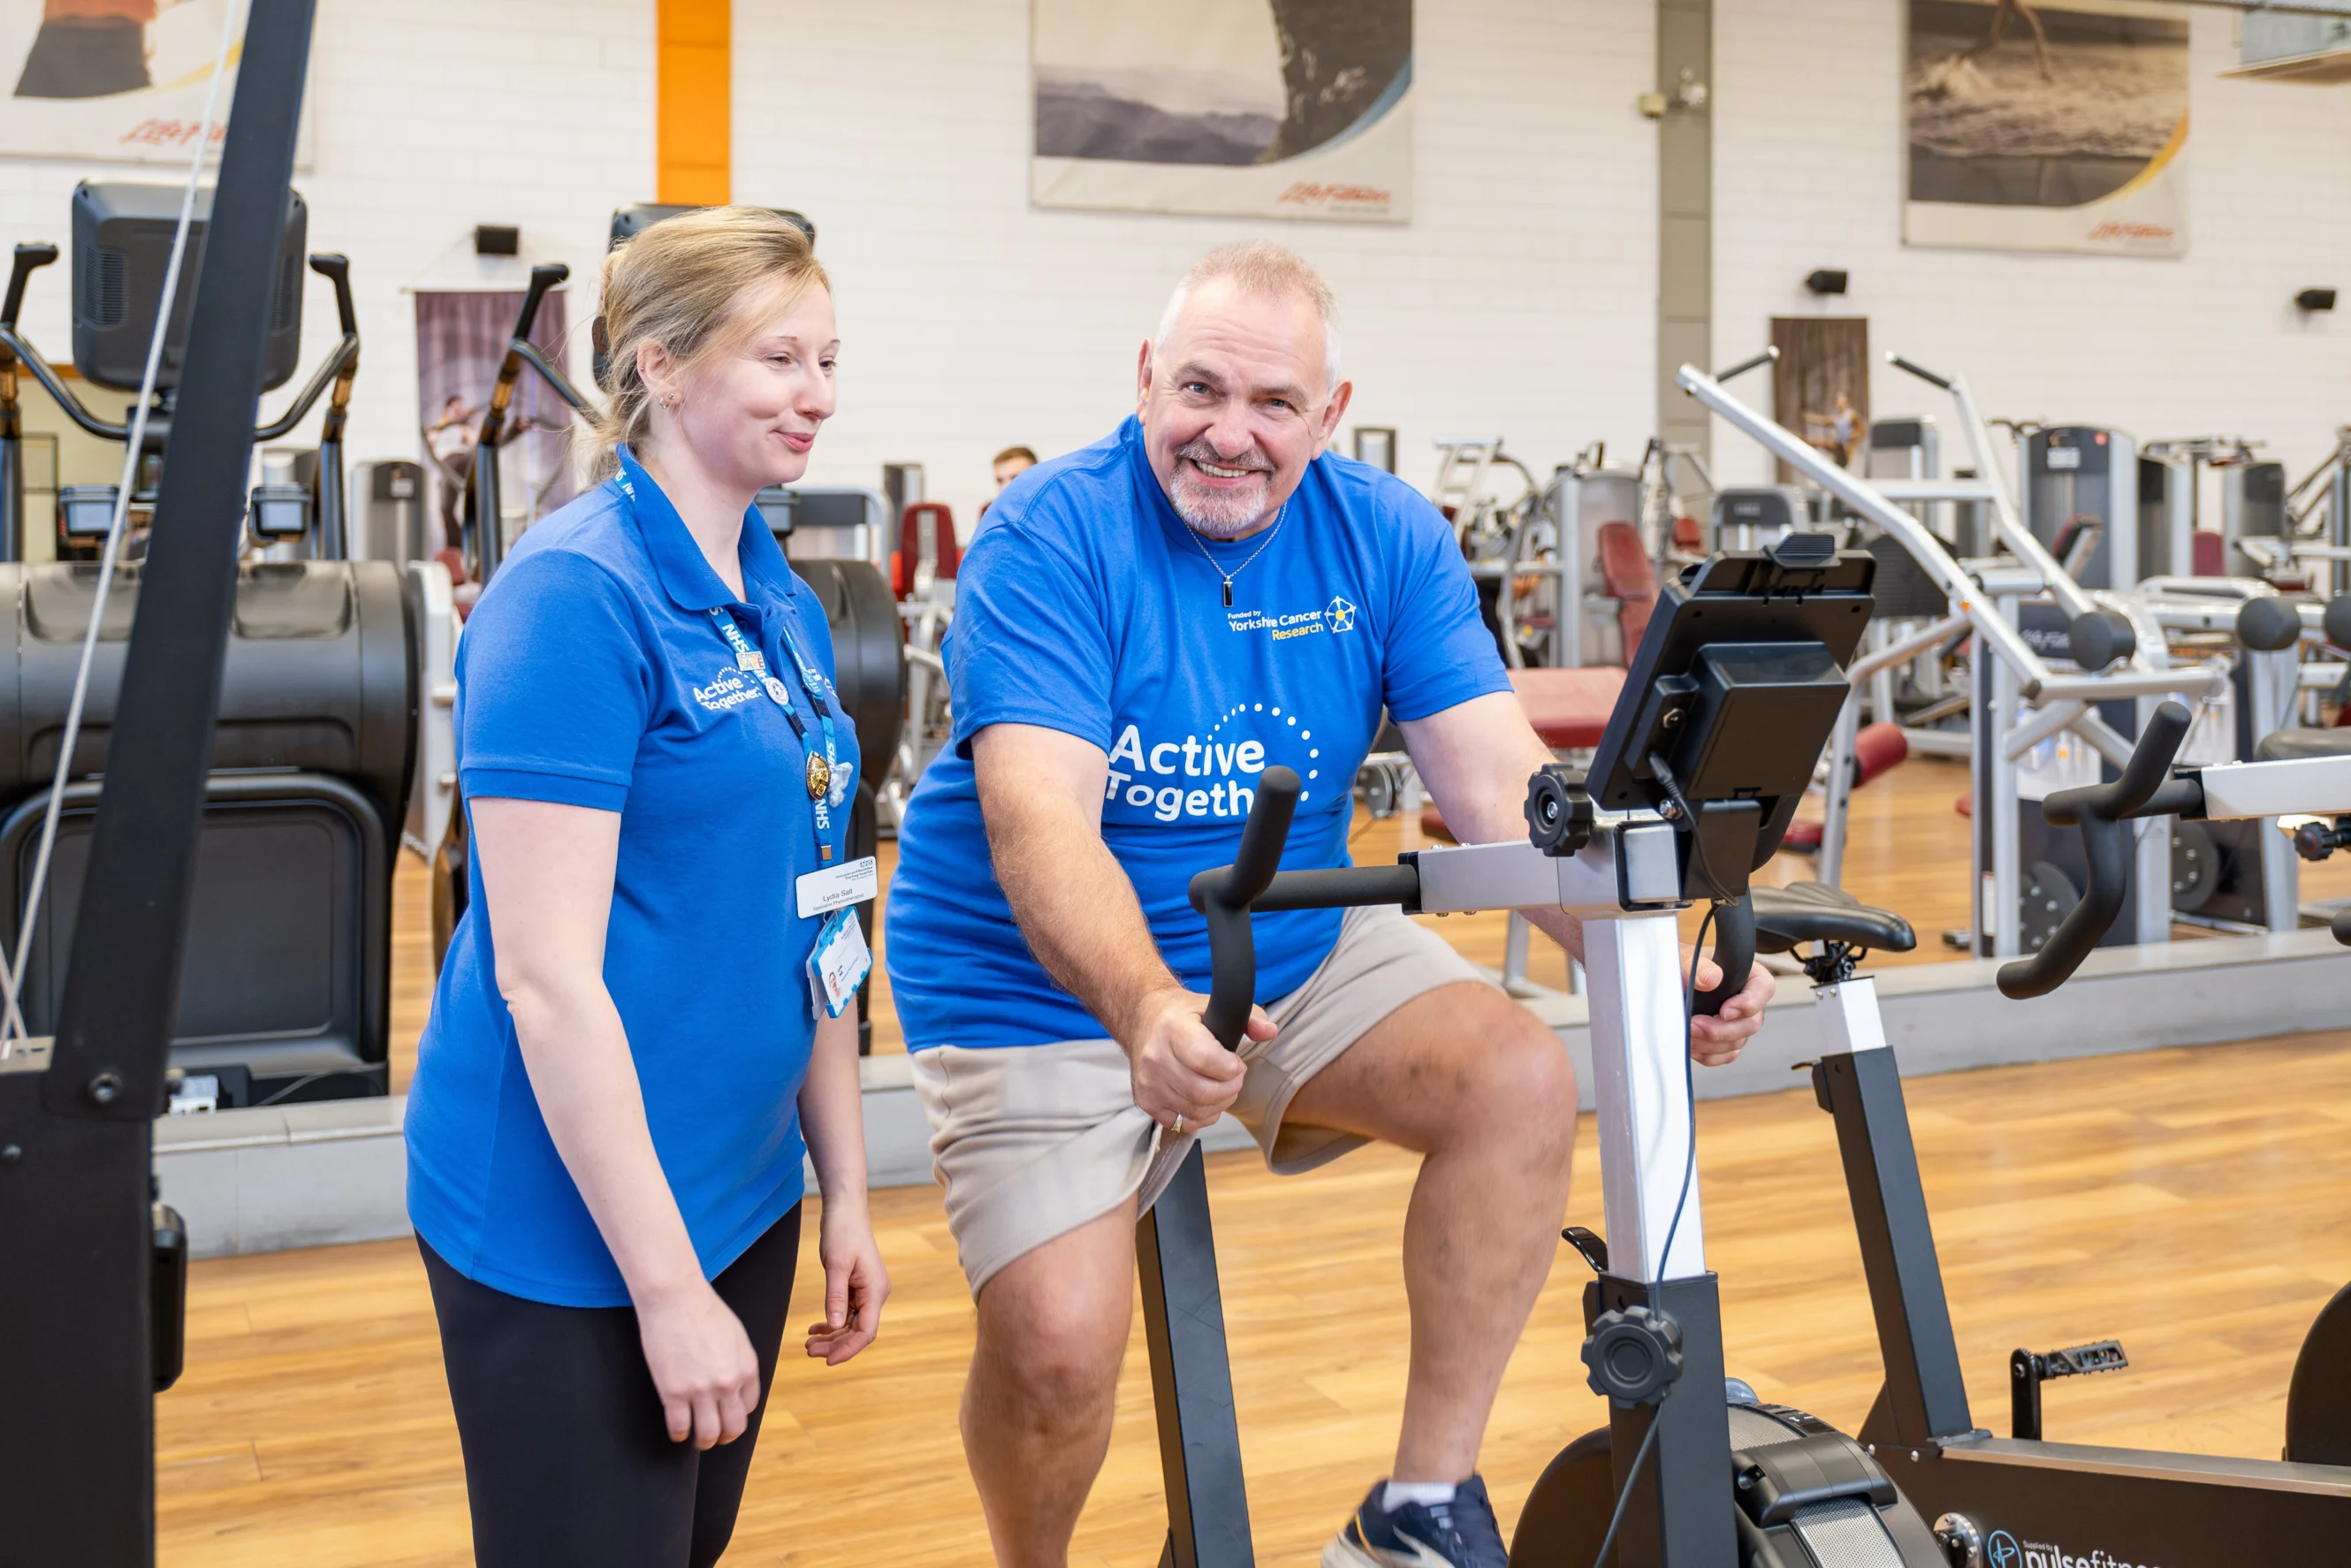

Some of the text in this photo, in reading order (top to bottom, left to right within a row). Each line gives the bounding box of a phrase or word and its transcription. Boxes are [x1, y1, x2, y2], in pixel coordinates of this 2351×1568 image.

[1229, 611, 1322, 632] Yorkshire Cancer
[1272, 621, 1324, 641] Research
[721, 623, 749, 653] NHS
[693, 678, 744, 702] Active
[1108, 724, 1266, 776] Active
[1105, 769, 1254, 822] Togeth
[815, 797, 830, 830] NHS
[823, 892, 840, 903] Lydia
[2046, 1542, 2053, 1552] by
